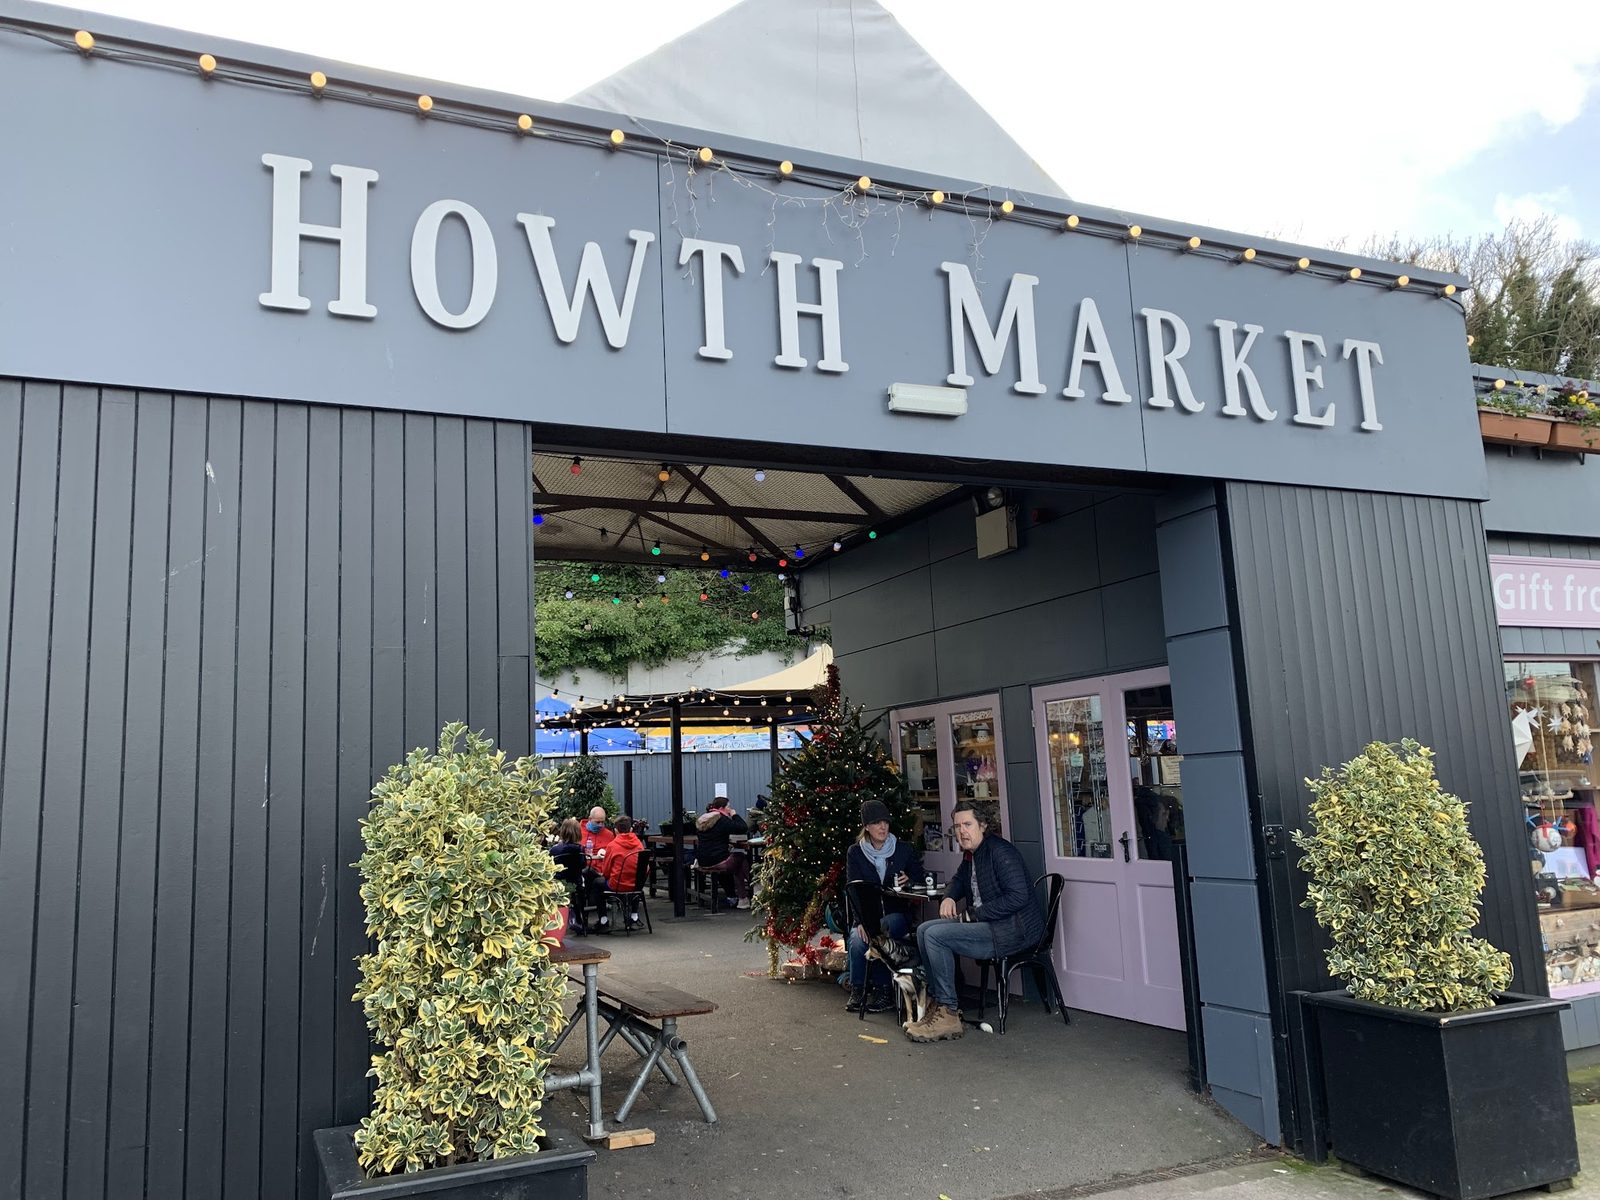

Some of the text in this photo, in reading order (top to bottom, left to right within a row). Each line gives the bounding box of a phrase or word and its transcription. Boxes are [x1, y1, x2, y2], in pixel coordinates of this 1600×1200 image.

[258, 153, 1385, 432] HOWTH MARKET
[1493, 572, 1553, 611] Gift
